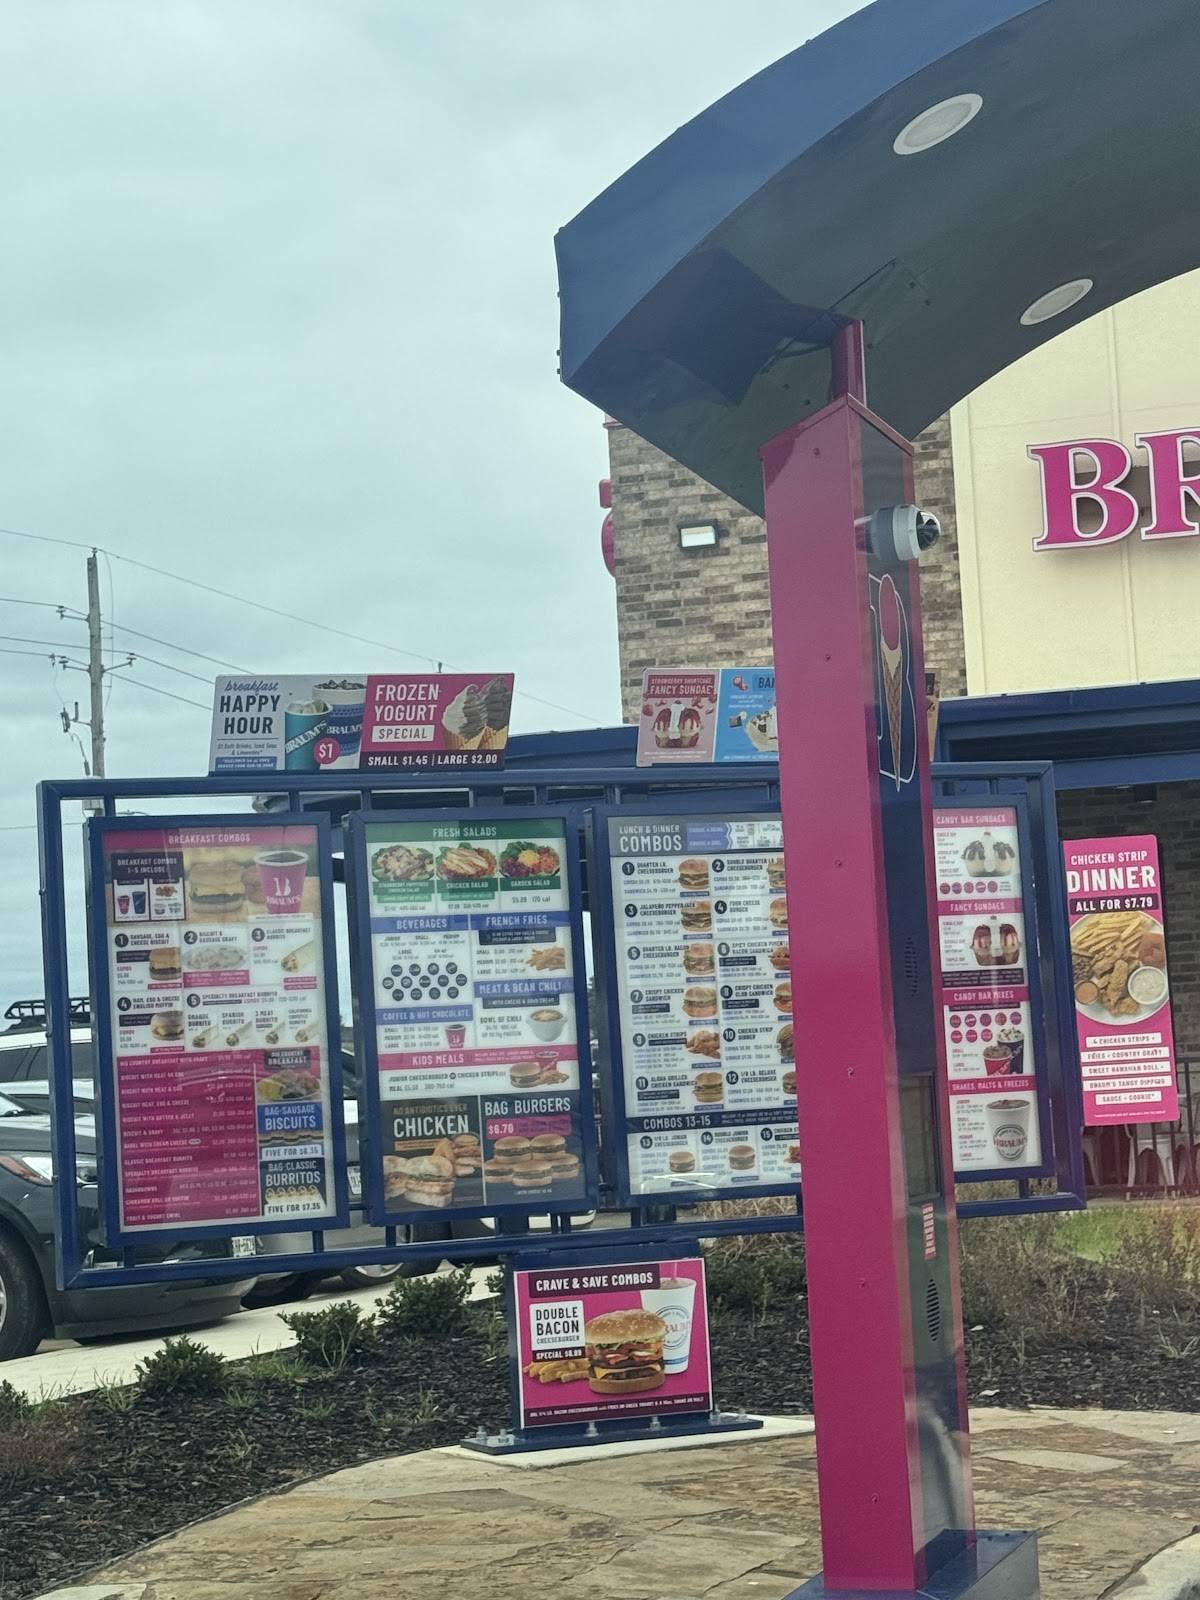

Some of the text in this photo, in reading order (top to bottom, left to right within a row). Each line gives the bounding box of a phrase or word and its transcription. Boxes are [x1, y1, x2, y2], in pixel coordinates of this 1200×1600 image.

[224, 680, 279, 695] breakfast
[375, 683, 439, 701] FROZEN
[650, 684, 711, 695] FANCY SUNDAE
[220, 695, 281, 712] HAPPY
[374, 704, 437, 722] YOGURT
[224, 717, 273, 734] HOUR
[285, 720, 327, 753] BRAUM'S
[378, 727, 427, 740] SPECIAL
[319, 743, 333, 760] $1
[367, 754, 498, 766] SMALL $1.45 LARGE $2.00
[936, 814, 1006, 824] CANDY BAR SUNDAES
[433, 827, 497, 838] FRESH SALADS
[620, 825, 643, 834] LUNCH
[645, 825, 651, 833] &
[653, 824, 680, 833] DINNER
[169, 833, 251, 845] BREAKFAST COMBOS
[620, 835, 682, 853] COMBOS
[117, 857, 151, 866] BREAKFAST
[1070, 850, 1148, 866] CHICKEN STRIP
[1066, 865, 1156, 893] DINNER
[950, 902, 1005, 911] FANCY SUNDAES
[1076, 897, 1153, 912] ALL FOR $7.79
[396, 918, 447, 929] BEVERAGES
[486, 915, 548, 926] FRENCH FRIES
[480, 981, 561, 994] MEAT & BEAN CHILI
[953, 990, 1014, 1001] CANDY BAR MIXES
[383, 1009, 470, 1020] COFFEE & HOT CHOCOLATE
[1128, 1035, 1150, 1043] STRIPS
[268, 1056, 306, 1065] BREAKFAST
[412, 1055, 433, 1065] KIDS
[436, 1054, 464, 1064] MEALS
[1088, 1052, 1105, 1060] FRIES
[1112, 1065, 1141, 1073] HAWAIIAN
[952, 1083, 976, 1091] SHAKES,
[1003, 1079, 1029, 1088] FREEZES
[1118, 1079, 1138, 1087] TANGY
[265, 1104, 315, 1115] BAG SAUSAGE
[485, 1097, 571, 1116] BAG BURGERS
[265, 1115, 316, 1131] BISCUITS
[393, 1115, 469, 1138] CHICKEN
[644, 1118, 683, 1130] COMBOS
[686, 1115, 711, 1127] 13-15
[488, 1123, 514, 1135] $6.70
[287, 1161, 317, 1170] CLASSIC
[266, 1171, 320, 1186] BURRITOS
[268, 1205, 284, 1213] FIVE
[287, 1203, 300, 1212] FOR
[536, 1272, 653, 1291] CRAVE & SAVE COMBOS
[536, 1307, 578, 1320] DOUBLE
[536, 1320, 579, 1336] BACON
[537, 1335, 580, 1344] CHEESEBURGER
[536, 1350, 562, 1360] SPECIAL
